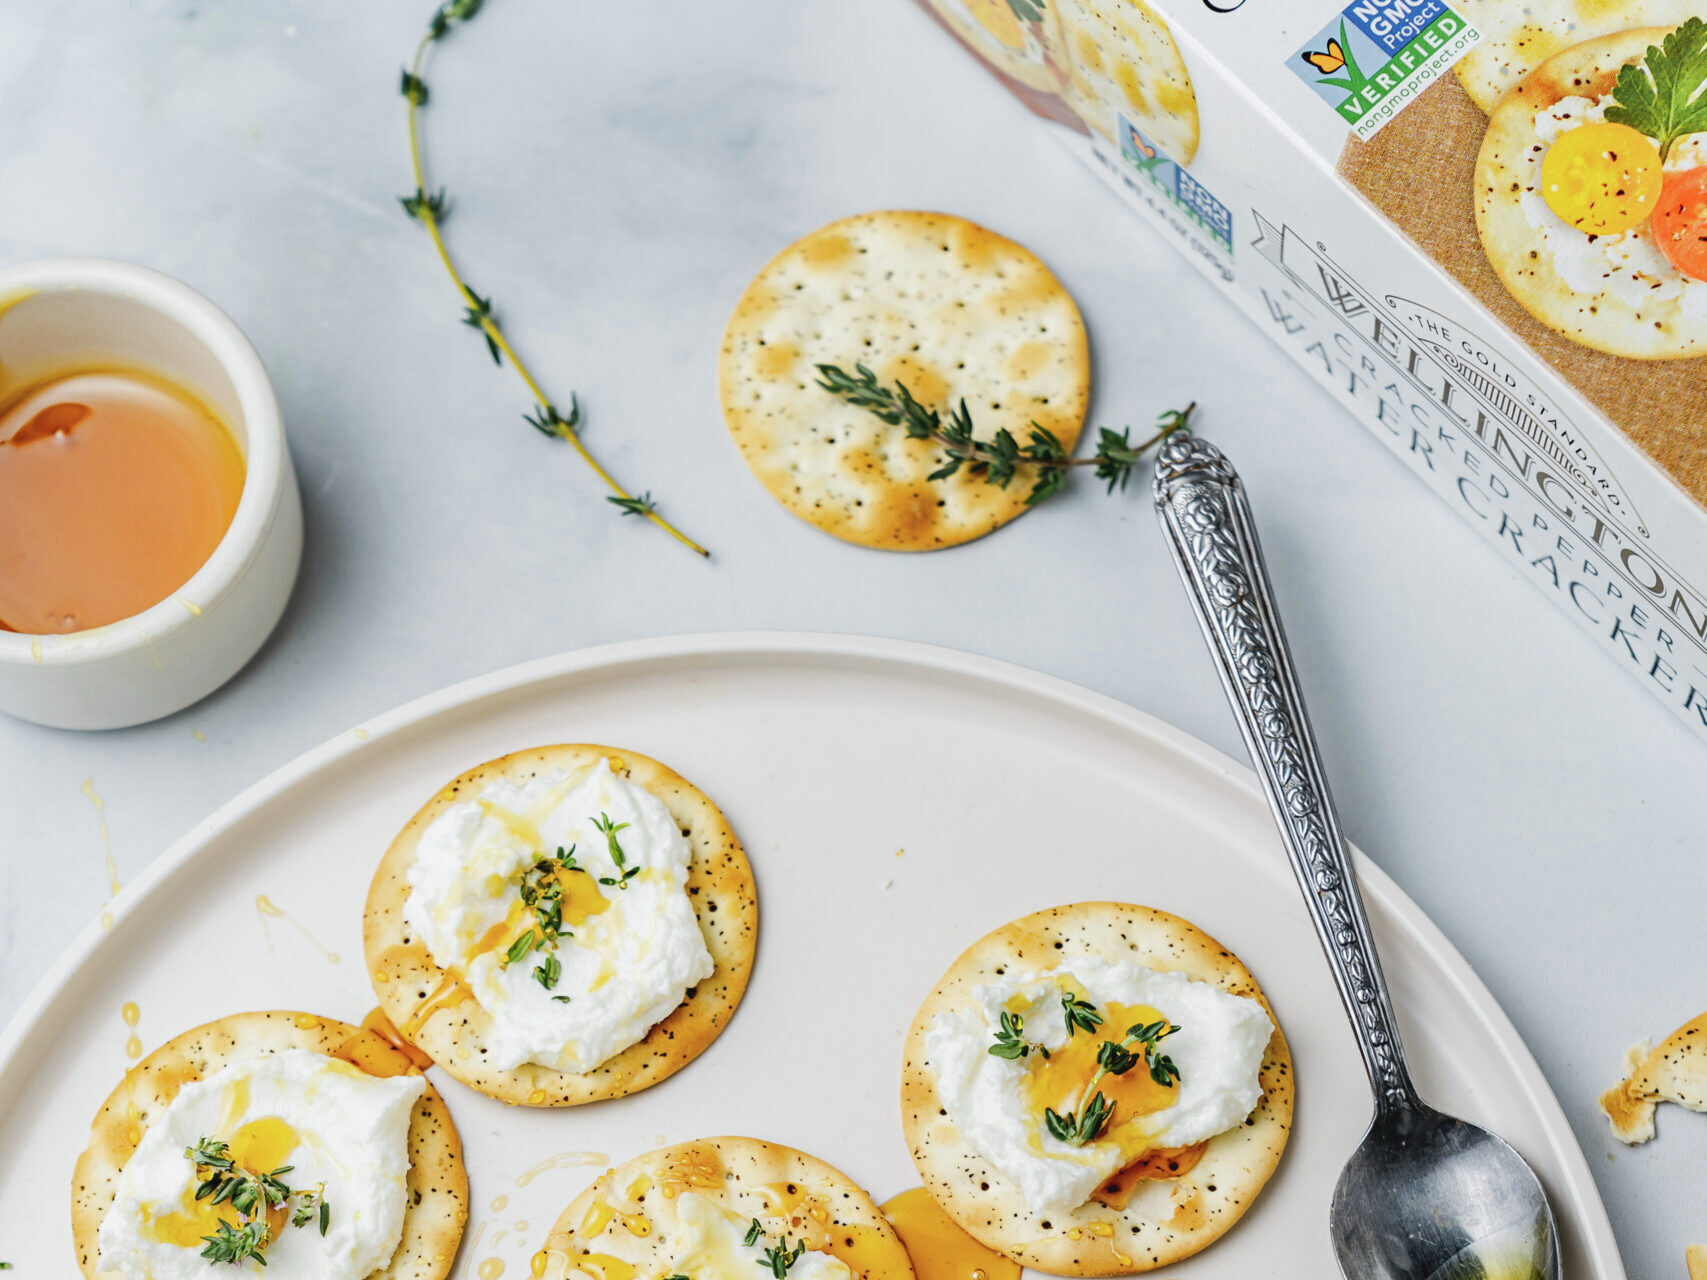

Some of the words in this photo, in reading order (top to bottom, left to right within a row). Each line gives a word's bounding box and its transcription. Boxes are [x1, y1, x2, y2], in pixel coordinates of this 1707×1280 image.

[1344, 18, 1458, 115] VERIFIED
[1383, 1, 1440, 50] Project
[1357, 28, 1480, 136] nongmoproject.org
[1180, 170, 1229, 220] NON
[1180, 182, 1229, 232] GMO
[1260, 286, 1435, 471] WATER
[1415, 314, 1452, 342] THE
[1461, 341, 1517, 388] GOLD
[1527, 393, 1620, 507] STANDARD
[1316, 262, 1707, 641] WELLINGTON
[1334, 333, 1509, 498] CRACKED
[1532, 513, 1674, 653] PEPPER
